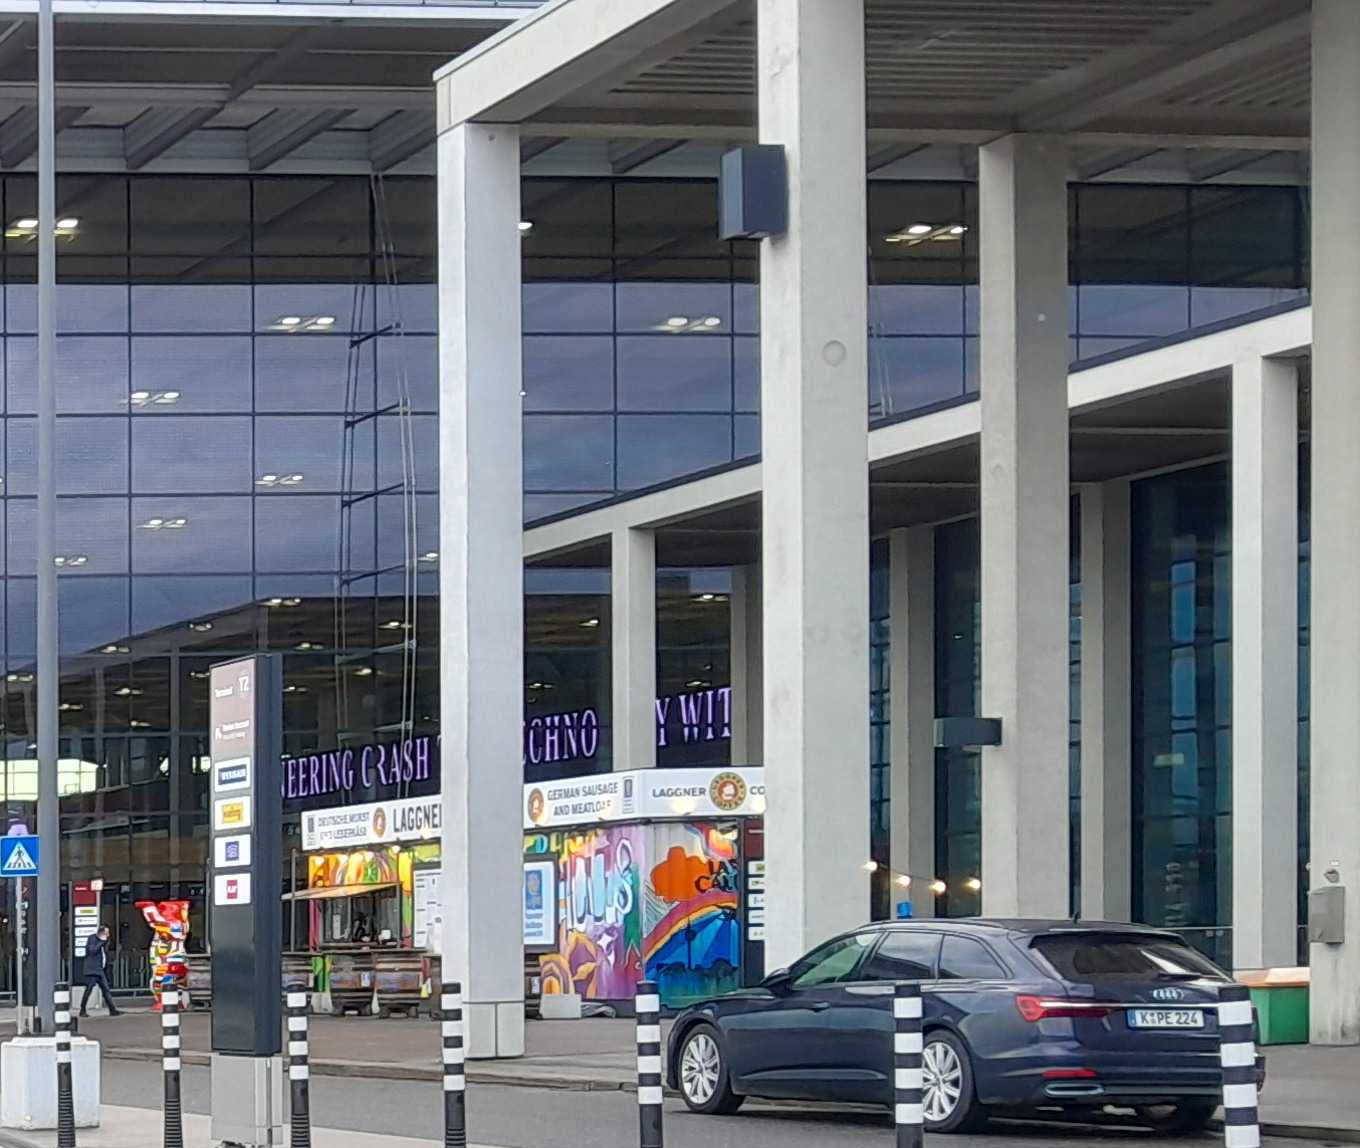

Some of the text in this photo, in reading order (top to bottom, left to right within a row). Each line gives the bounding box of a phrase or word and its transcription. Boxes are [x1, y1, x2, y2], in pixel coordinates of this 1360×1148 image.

[362, 737, 429, 788] CRASH
[547, 782, 618, 801] GERMAN SAUSAGE
[652, 787, 706, 798] LAGGNER
[553, 804, 570, 816] AND
